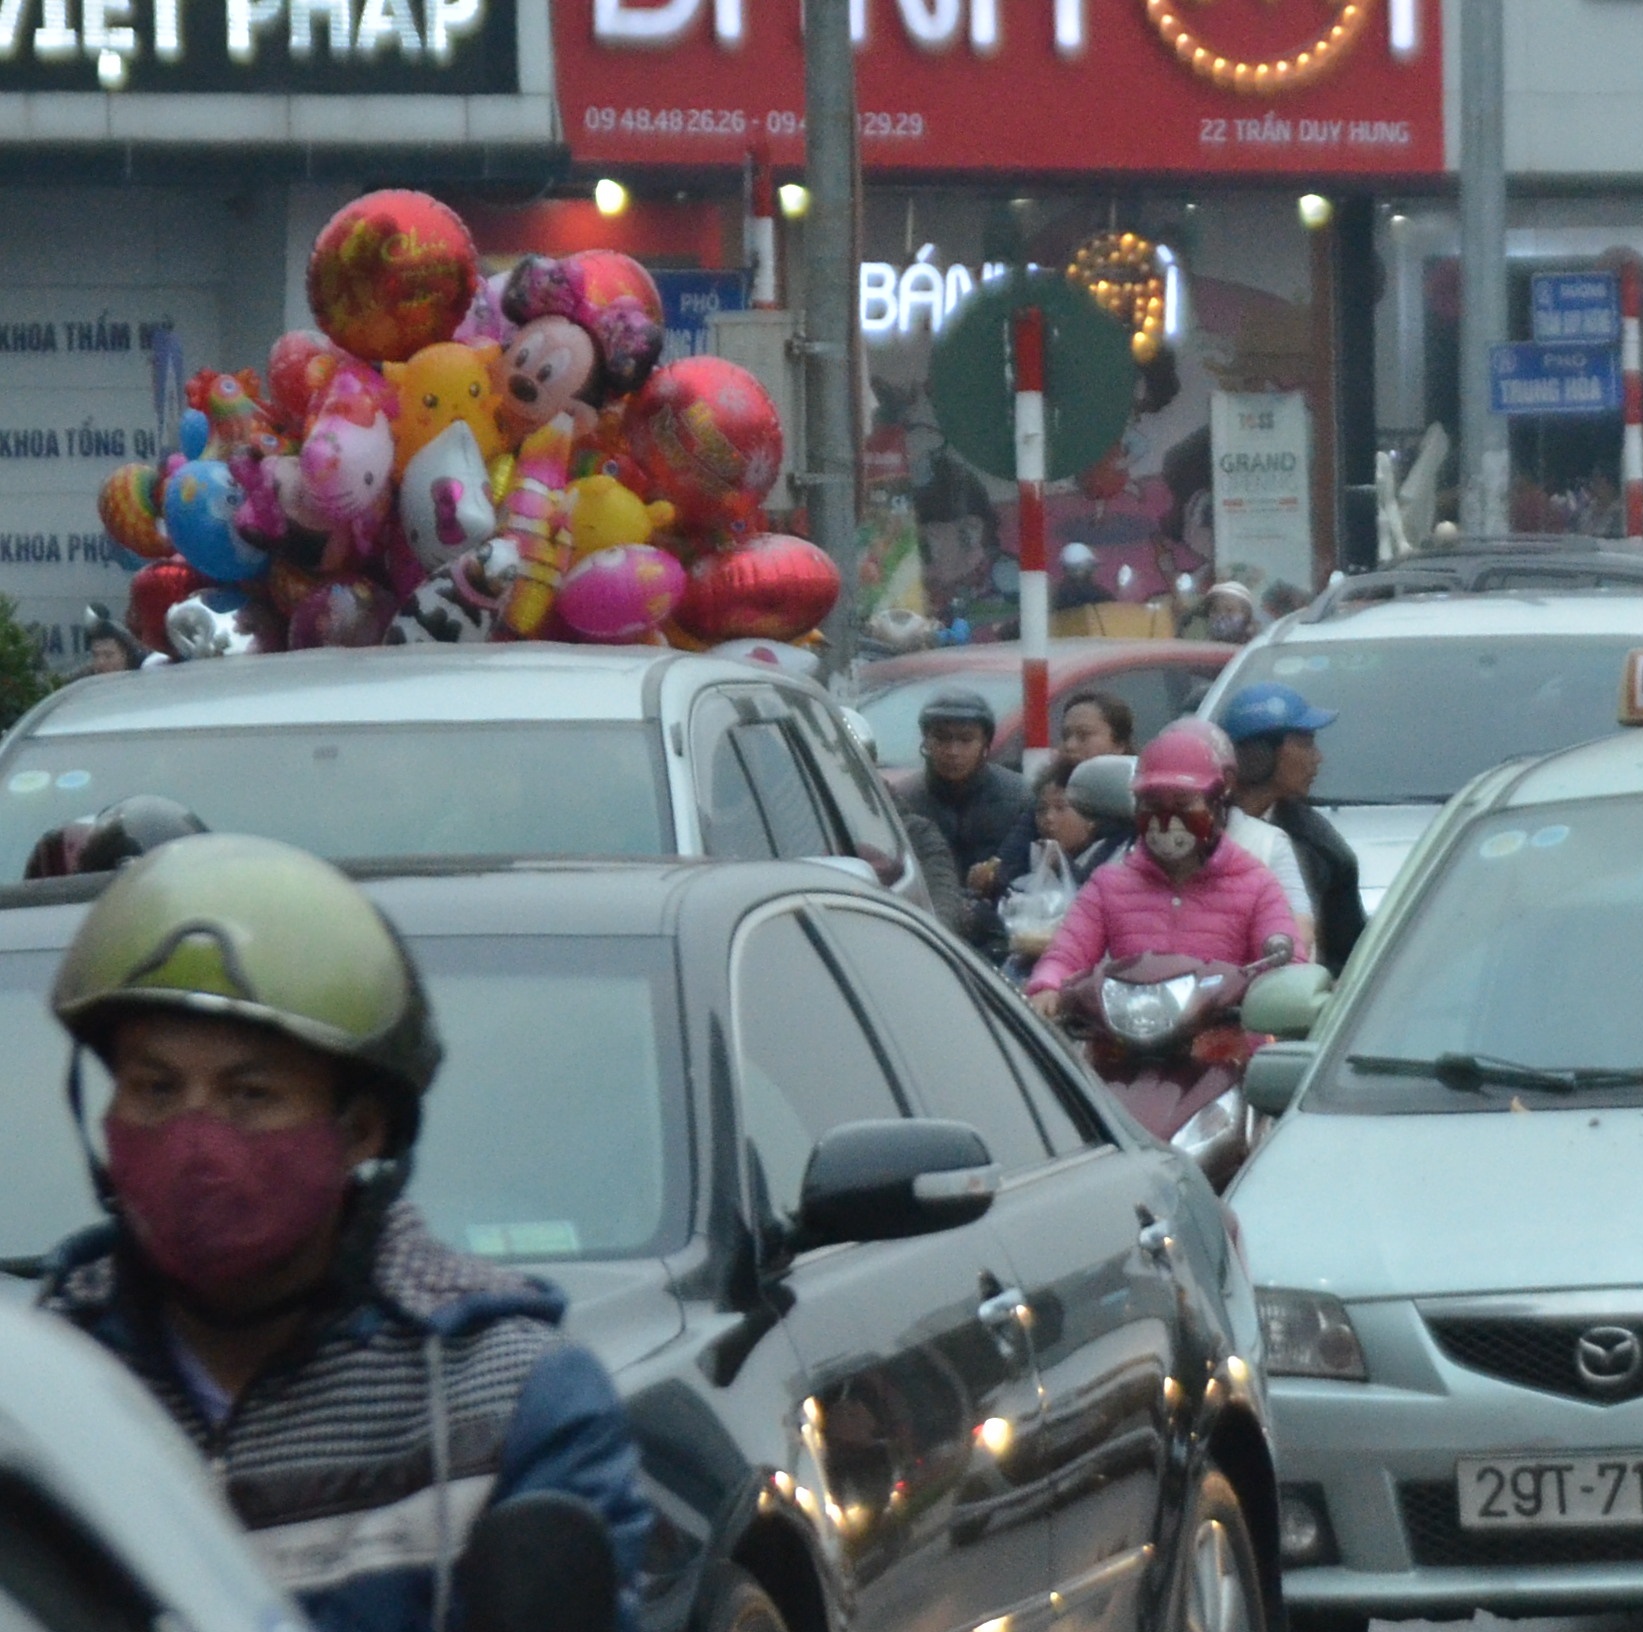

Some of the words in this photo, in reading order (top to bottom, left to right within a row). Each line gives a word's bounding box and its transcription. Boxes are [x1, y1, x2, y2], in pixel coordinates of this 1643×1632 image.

[1201, 118, 1227, 142] 22
[1301, 119, 1340, 142] DUY
[0, 429, 60, 457] KHOA
[1219, 451, 1297, 474] GRAND
[1, 533, 62, 562] KHOA
